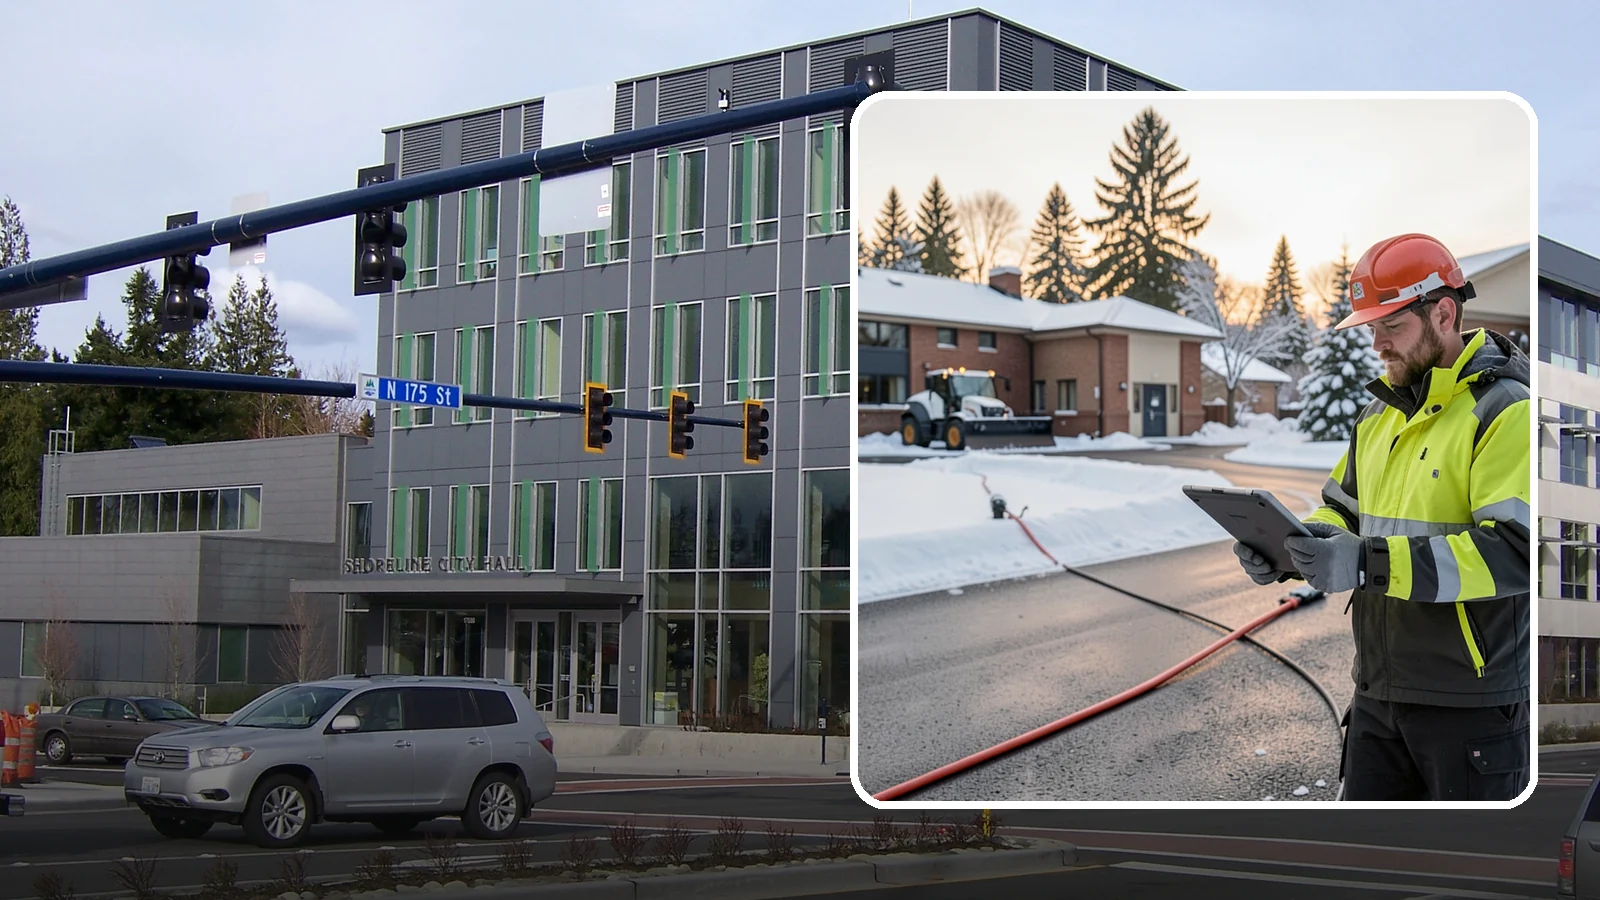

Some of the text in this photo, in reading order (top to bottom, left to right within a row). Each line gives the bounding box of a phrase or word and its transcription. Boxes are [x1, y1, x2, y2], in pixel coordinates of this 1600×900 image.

[387, 381, 451, 406] N 175 St
[345, 555, 525, 574] SHORELINE CITY HALL
